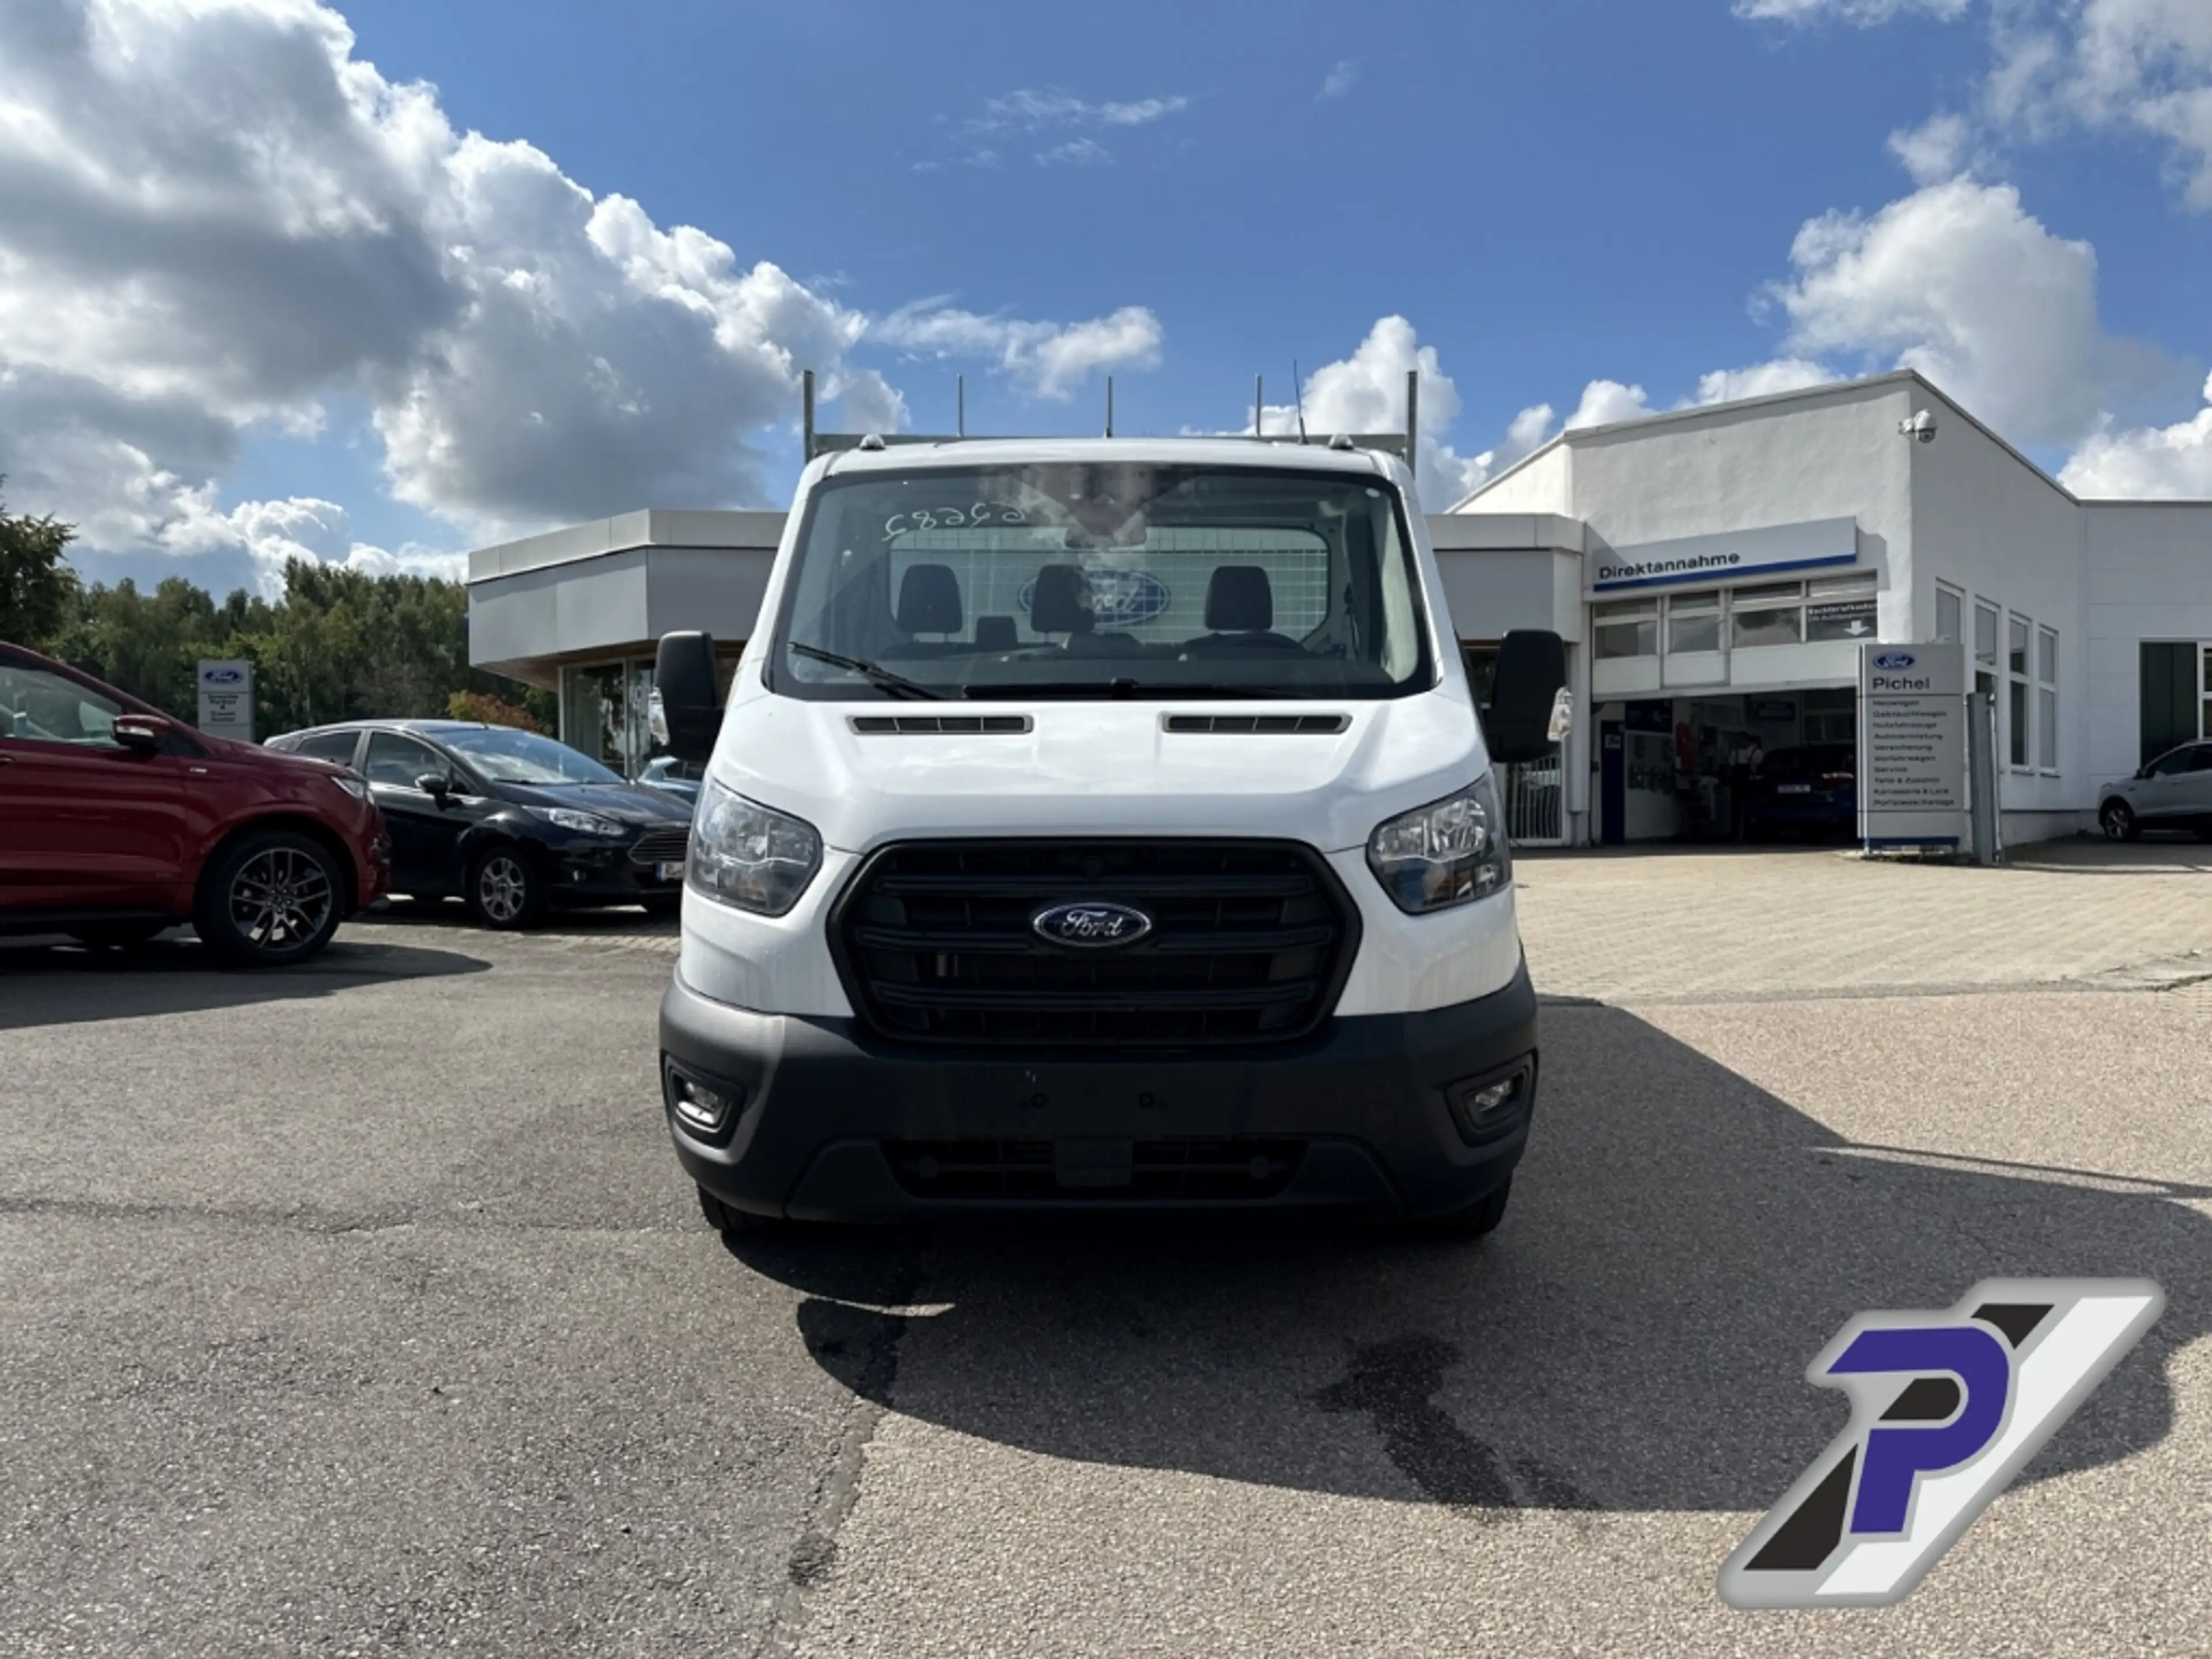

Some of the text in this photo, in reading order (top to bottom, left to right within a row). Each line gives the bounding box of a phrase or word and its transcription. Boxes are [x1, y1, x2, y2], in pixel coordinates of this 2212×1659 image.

[1599, 552, 1740, 579] Direktannahme
[1873, 676, 1930, 690] Pichel
[1060, 908, 1124, 937] Ford
